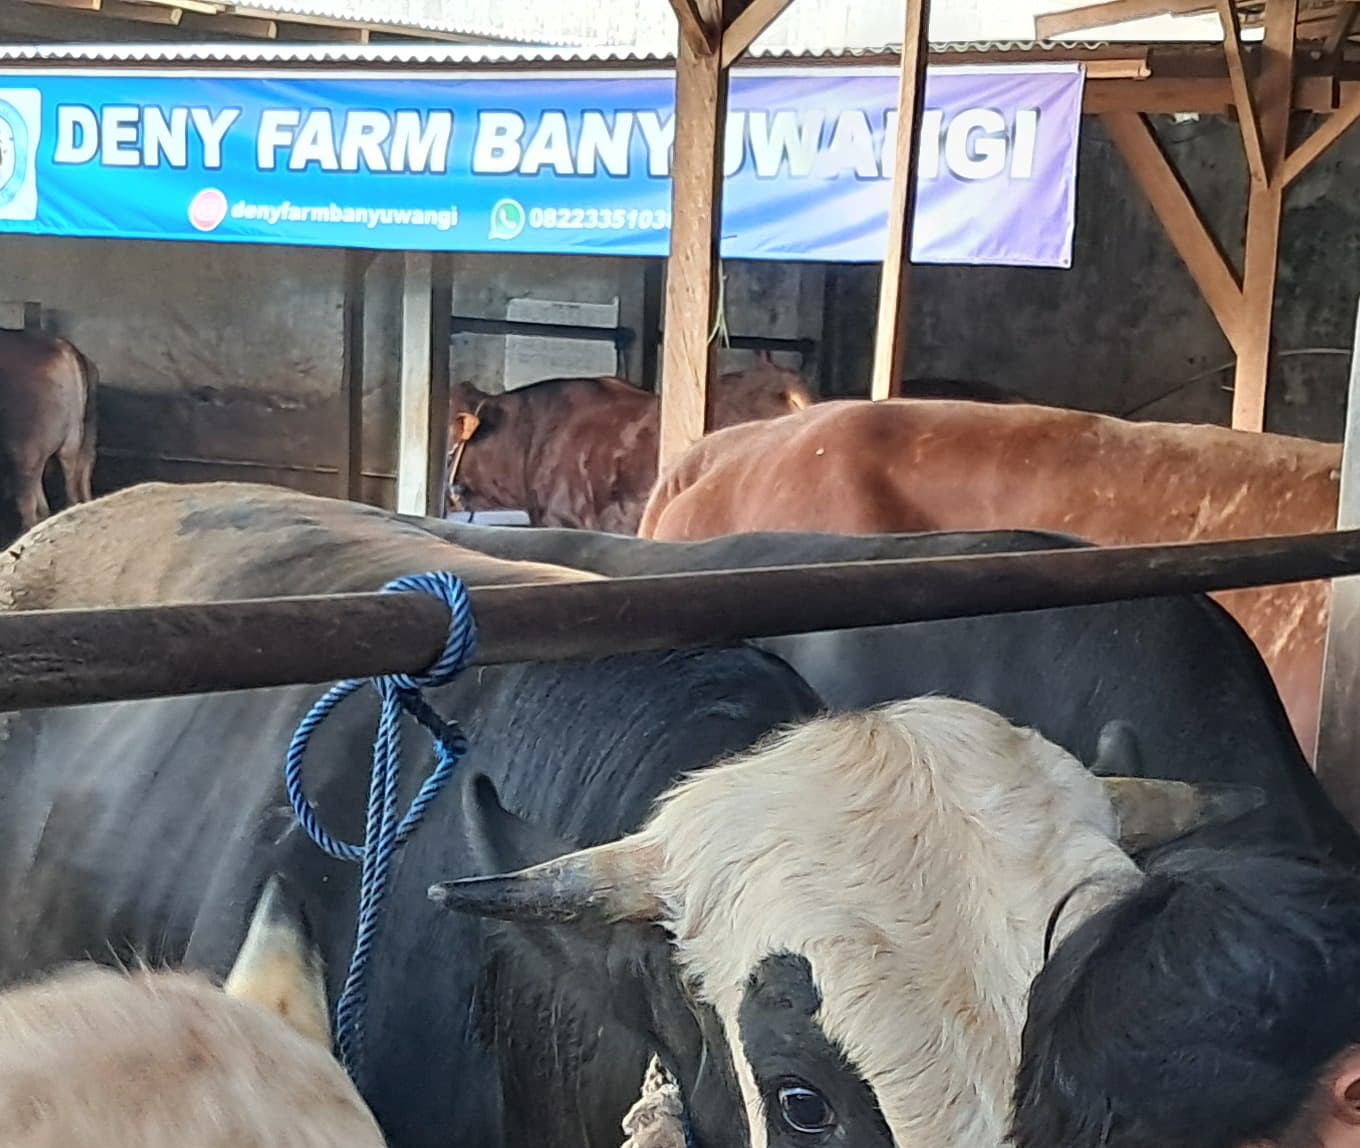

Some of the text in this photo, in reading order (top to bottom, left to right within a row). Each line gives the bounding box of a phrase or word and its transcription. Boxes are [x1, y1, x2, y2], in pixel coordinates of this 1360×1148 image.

[52, 103, 242, 170] DENY
[255, 107, 454, 174] FARM
[230, 200, 459, 231] denyfarmbanyuwangi
